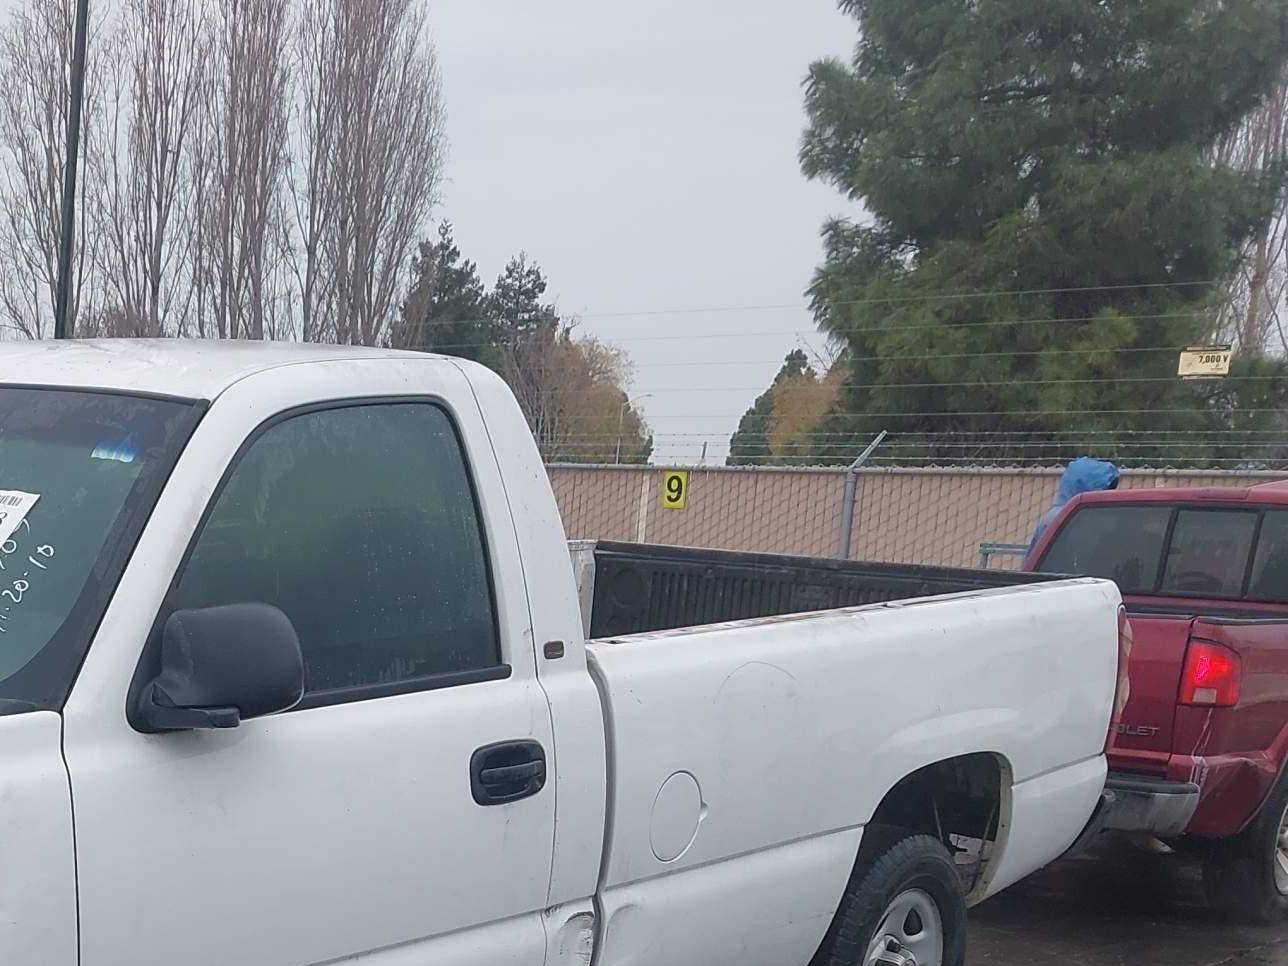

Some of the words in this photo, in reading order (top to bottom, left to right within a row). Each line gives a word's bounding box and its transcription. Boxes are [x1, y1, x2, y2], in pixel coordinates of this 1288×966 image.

[1199, 355, 1221, 365] 7,000
[1223, 354, 1229, 363] V
[667, 475, 683, 503] 9
